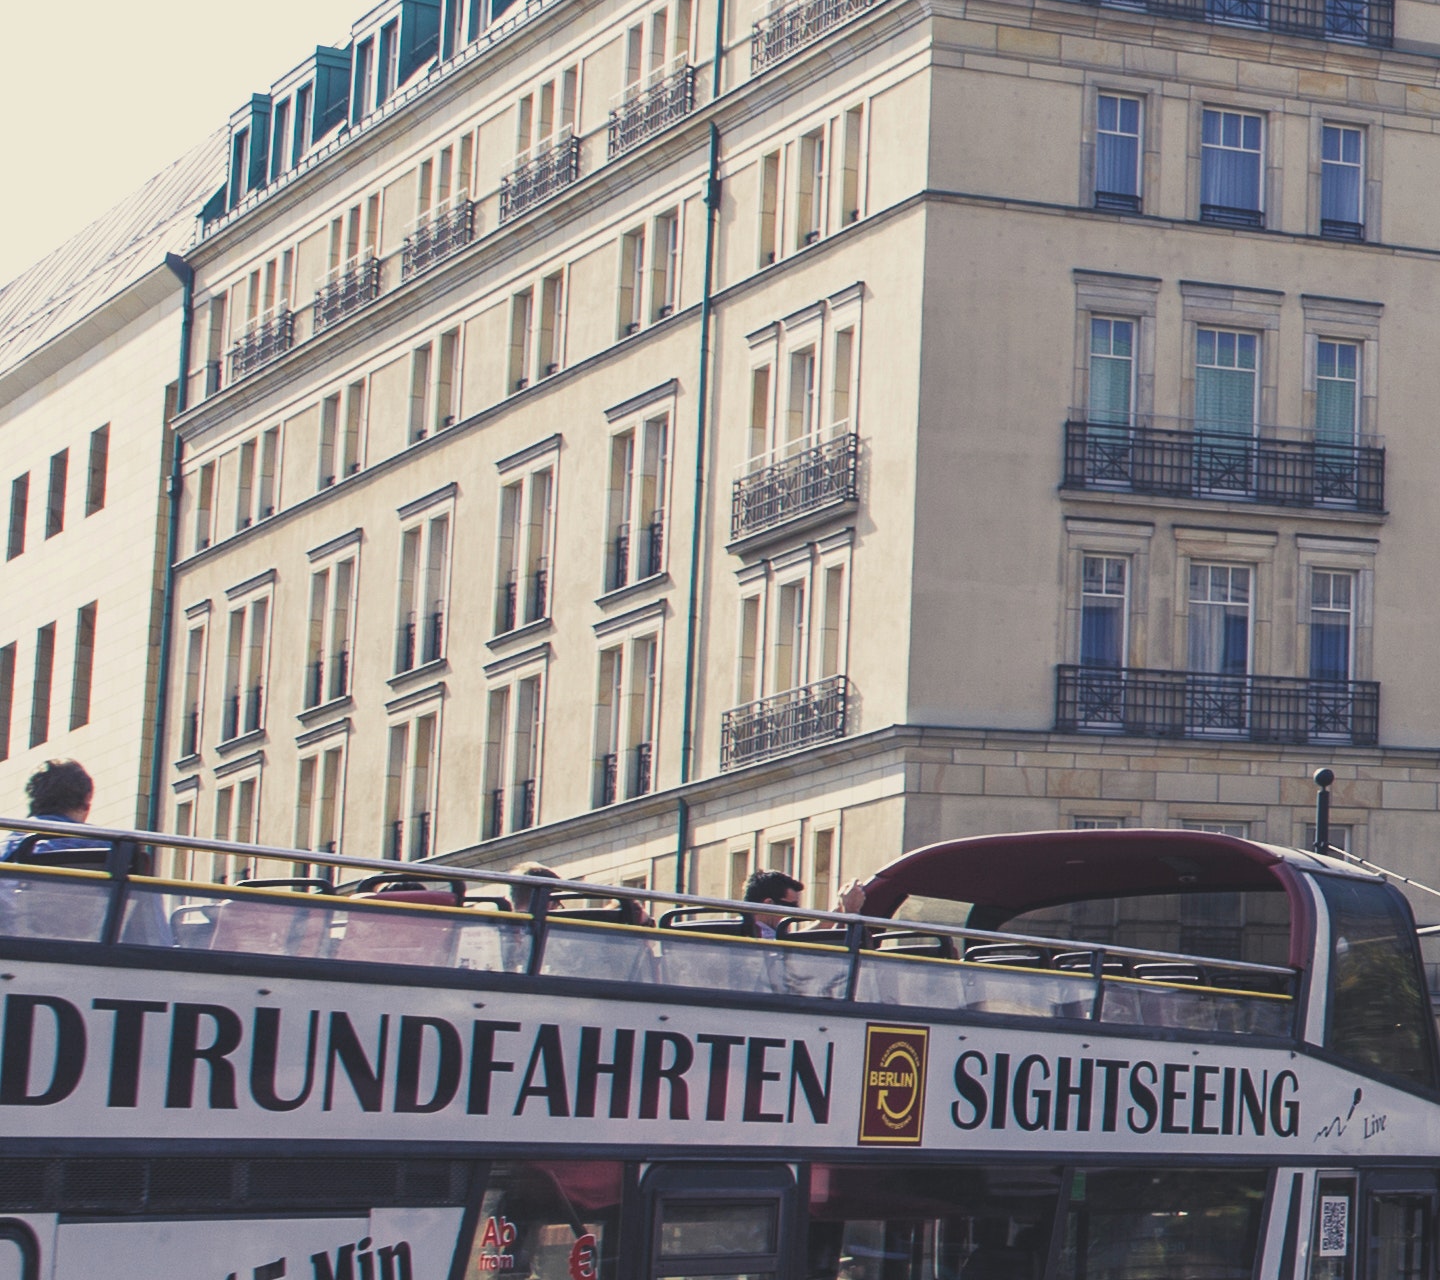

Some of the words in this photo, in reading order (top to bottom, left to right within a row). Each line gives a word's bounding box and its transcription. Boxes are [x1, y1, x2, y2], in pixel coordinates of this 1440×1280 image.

[0, 993, 833, 1123] DTRUNDFAHRTEN
[870, 1071, 913, 1087] BERLIN
[951, 1050, 1299, 1138] SIGHTSEEING
[1364, 1114, 1387, 1139] Live
[481, 1215, 516, 1248] Ab
[479, 1251, 514, 1271] from
